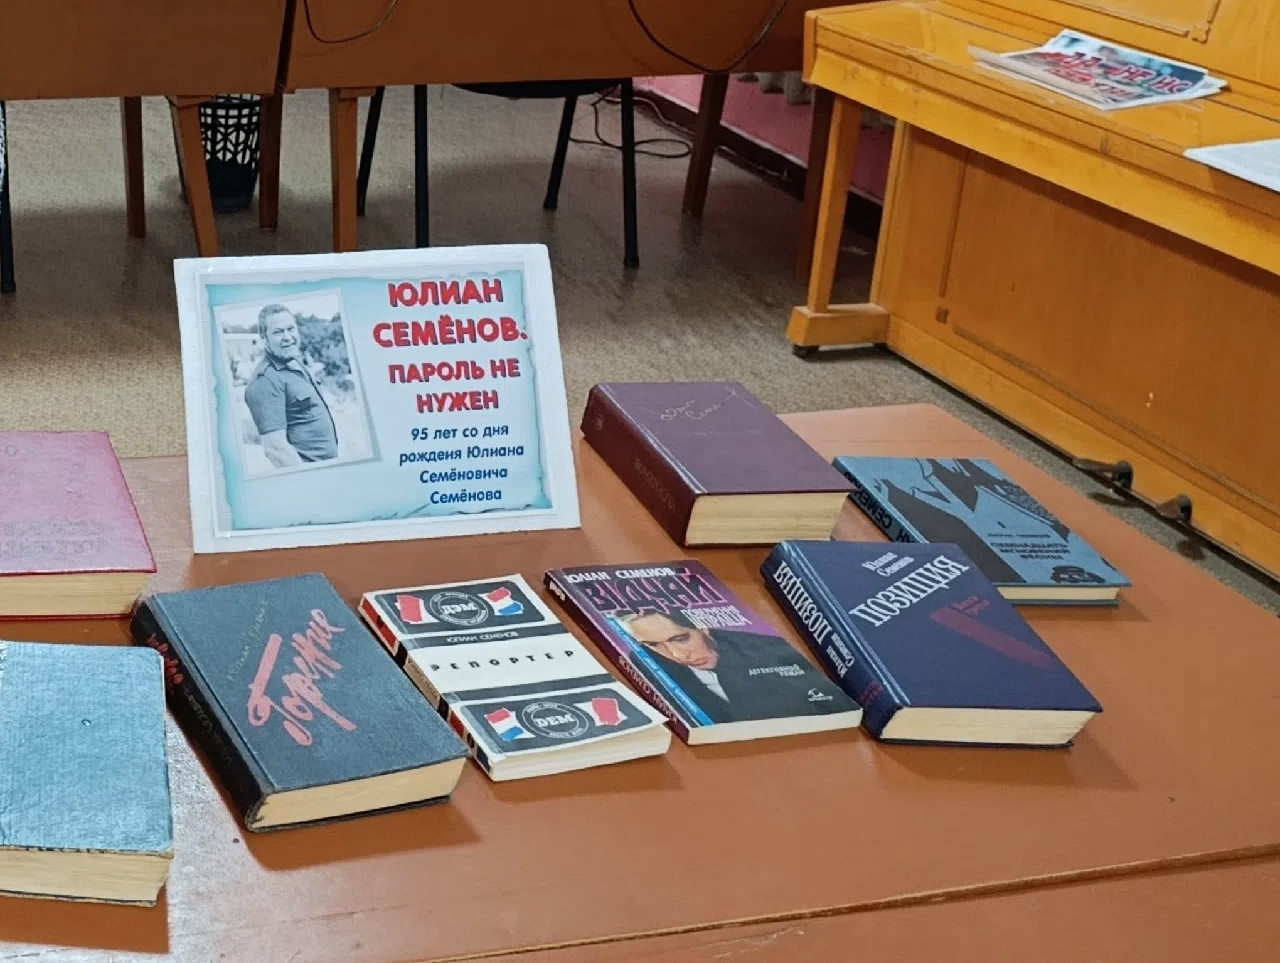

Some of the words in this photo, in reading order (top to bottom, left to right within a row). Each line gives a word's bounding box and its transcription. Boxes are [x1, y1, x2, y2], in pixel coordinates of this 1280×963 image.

[388, 278, 504, 308] ЮЛИАН
[373, 314, 529, 348] СЕМЁНОВ.
[388, 360, 485, 384] ПАРОЛЬ
[490, 358, 521, 379] НЕ
[416, 389, 499, 414] НУЖЕН
[411, 427, 429, 441] 95
[433, 428, 458, 440] лет
[462, 427, 478, 438] со
[482, 425, 509, 438] дня
[466, 444, 525, 459] Юлиана
[419, 467, 508, 484] Семёновича
[429, 488, 502, 505] Семёнова
[615, 567, 675, 579] СЕМЕНОВ
[773, 560, 832, 645] ПОЗИЦИЯ
[848, 554, 970, 627] ПОЗИЦИЯ
[429, 649, 575, 672] РЕПОРТЕР
